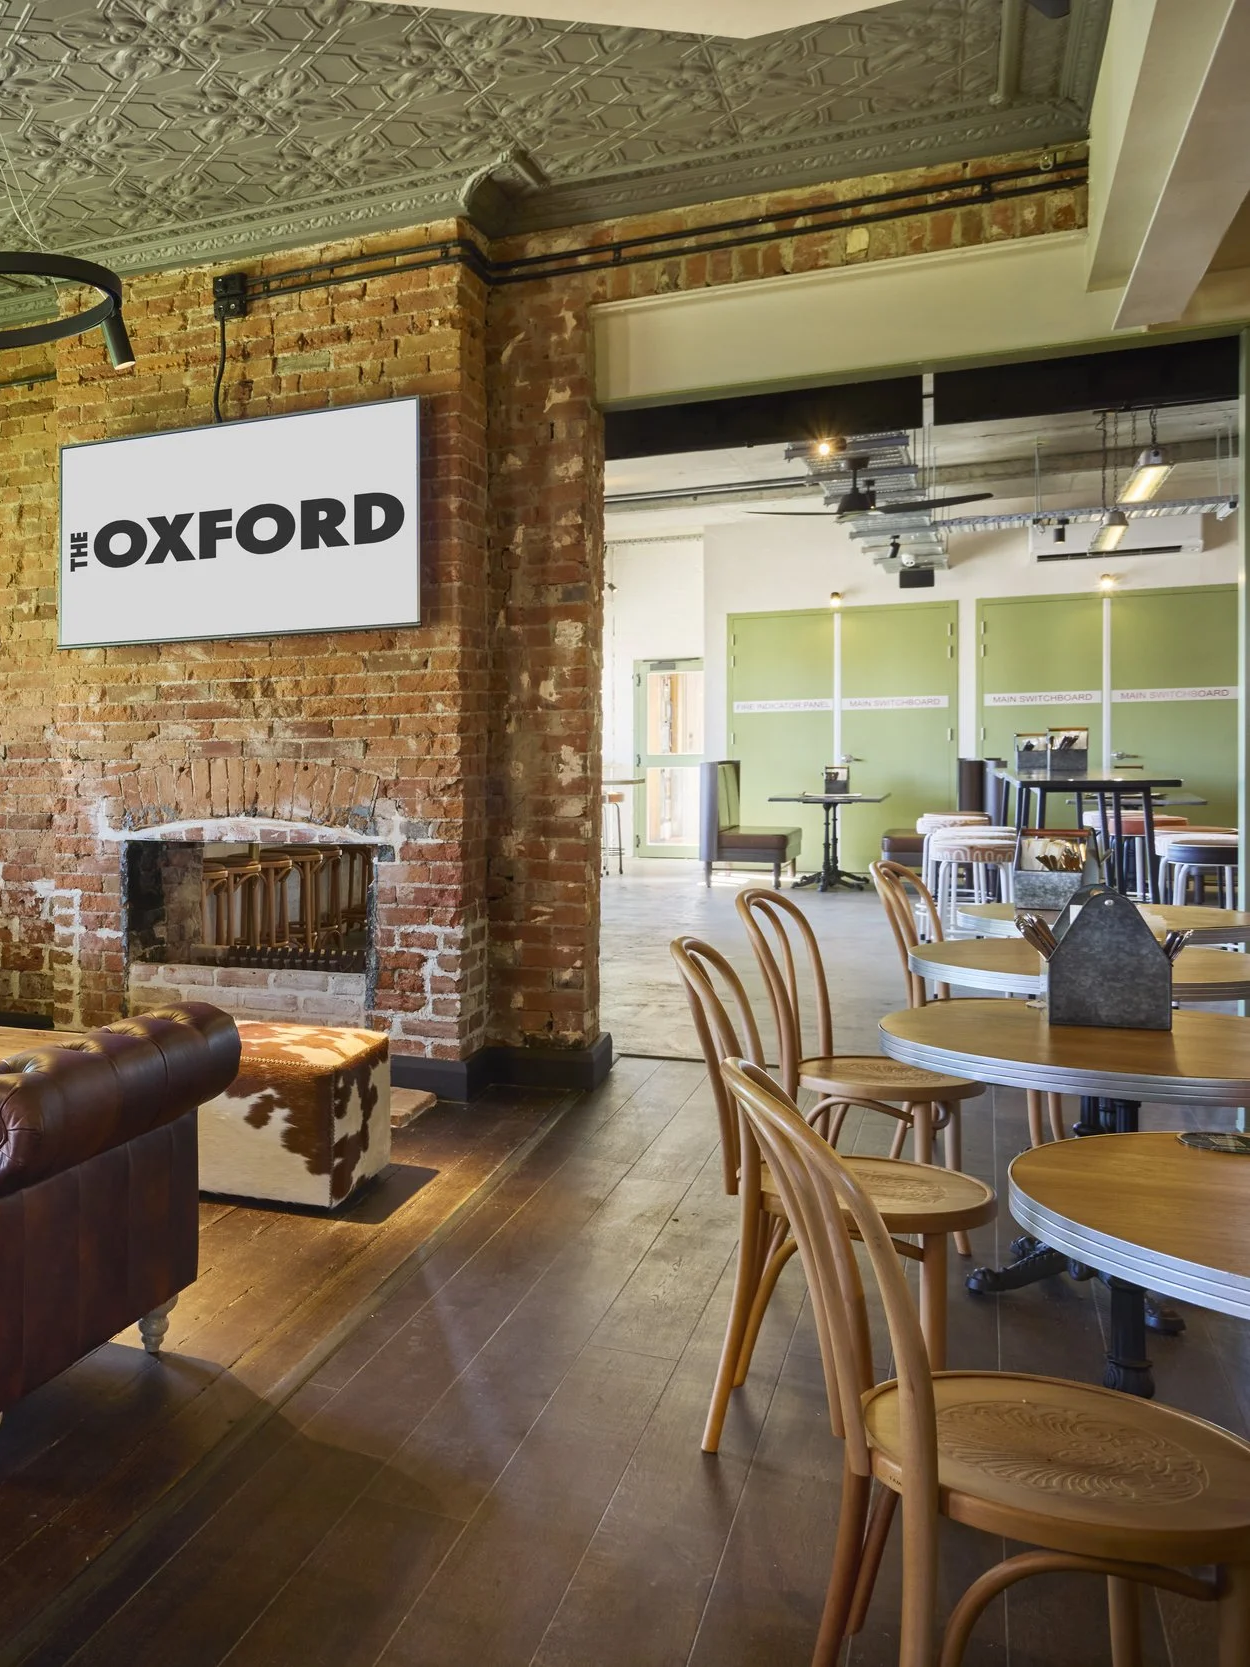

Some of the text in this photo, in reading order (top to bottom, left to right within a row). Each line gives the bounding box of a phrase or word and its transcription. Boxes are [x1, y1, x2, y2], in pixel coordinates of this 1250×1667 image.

[70, 492, 405, 572] THE OXFORD
[993, 693, 1093, 704] MAIN SWITCHBOARD
[1120, 688, 1230, 700] MAIN SWITCHBOARD
[736, 701, 830, 711] FIRE INDICATOR PANEL
[873, 698, 940, 707] SWITCHBOARD
